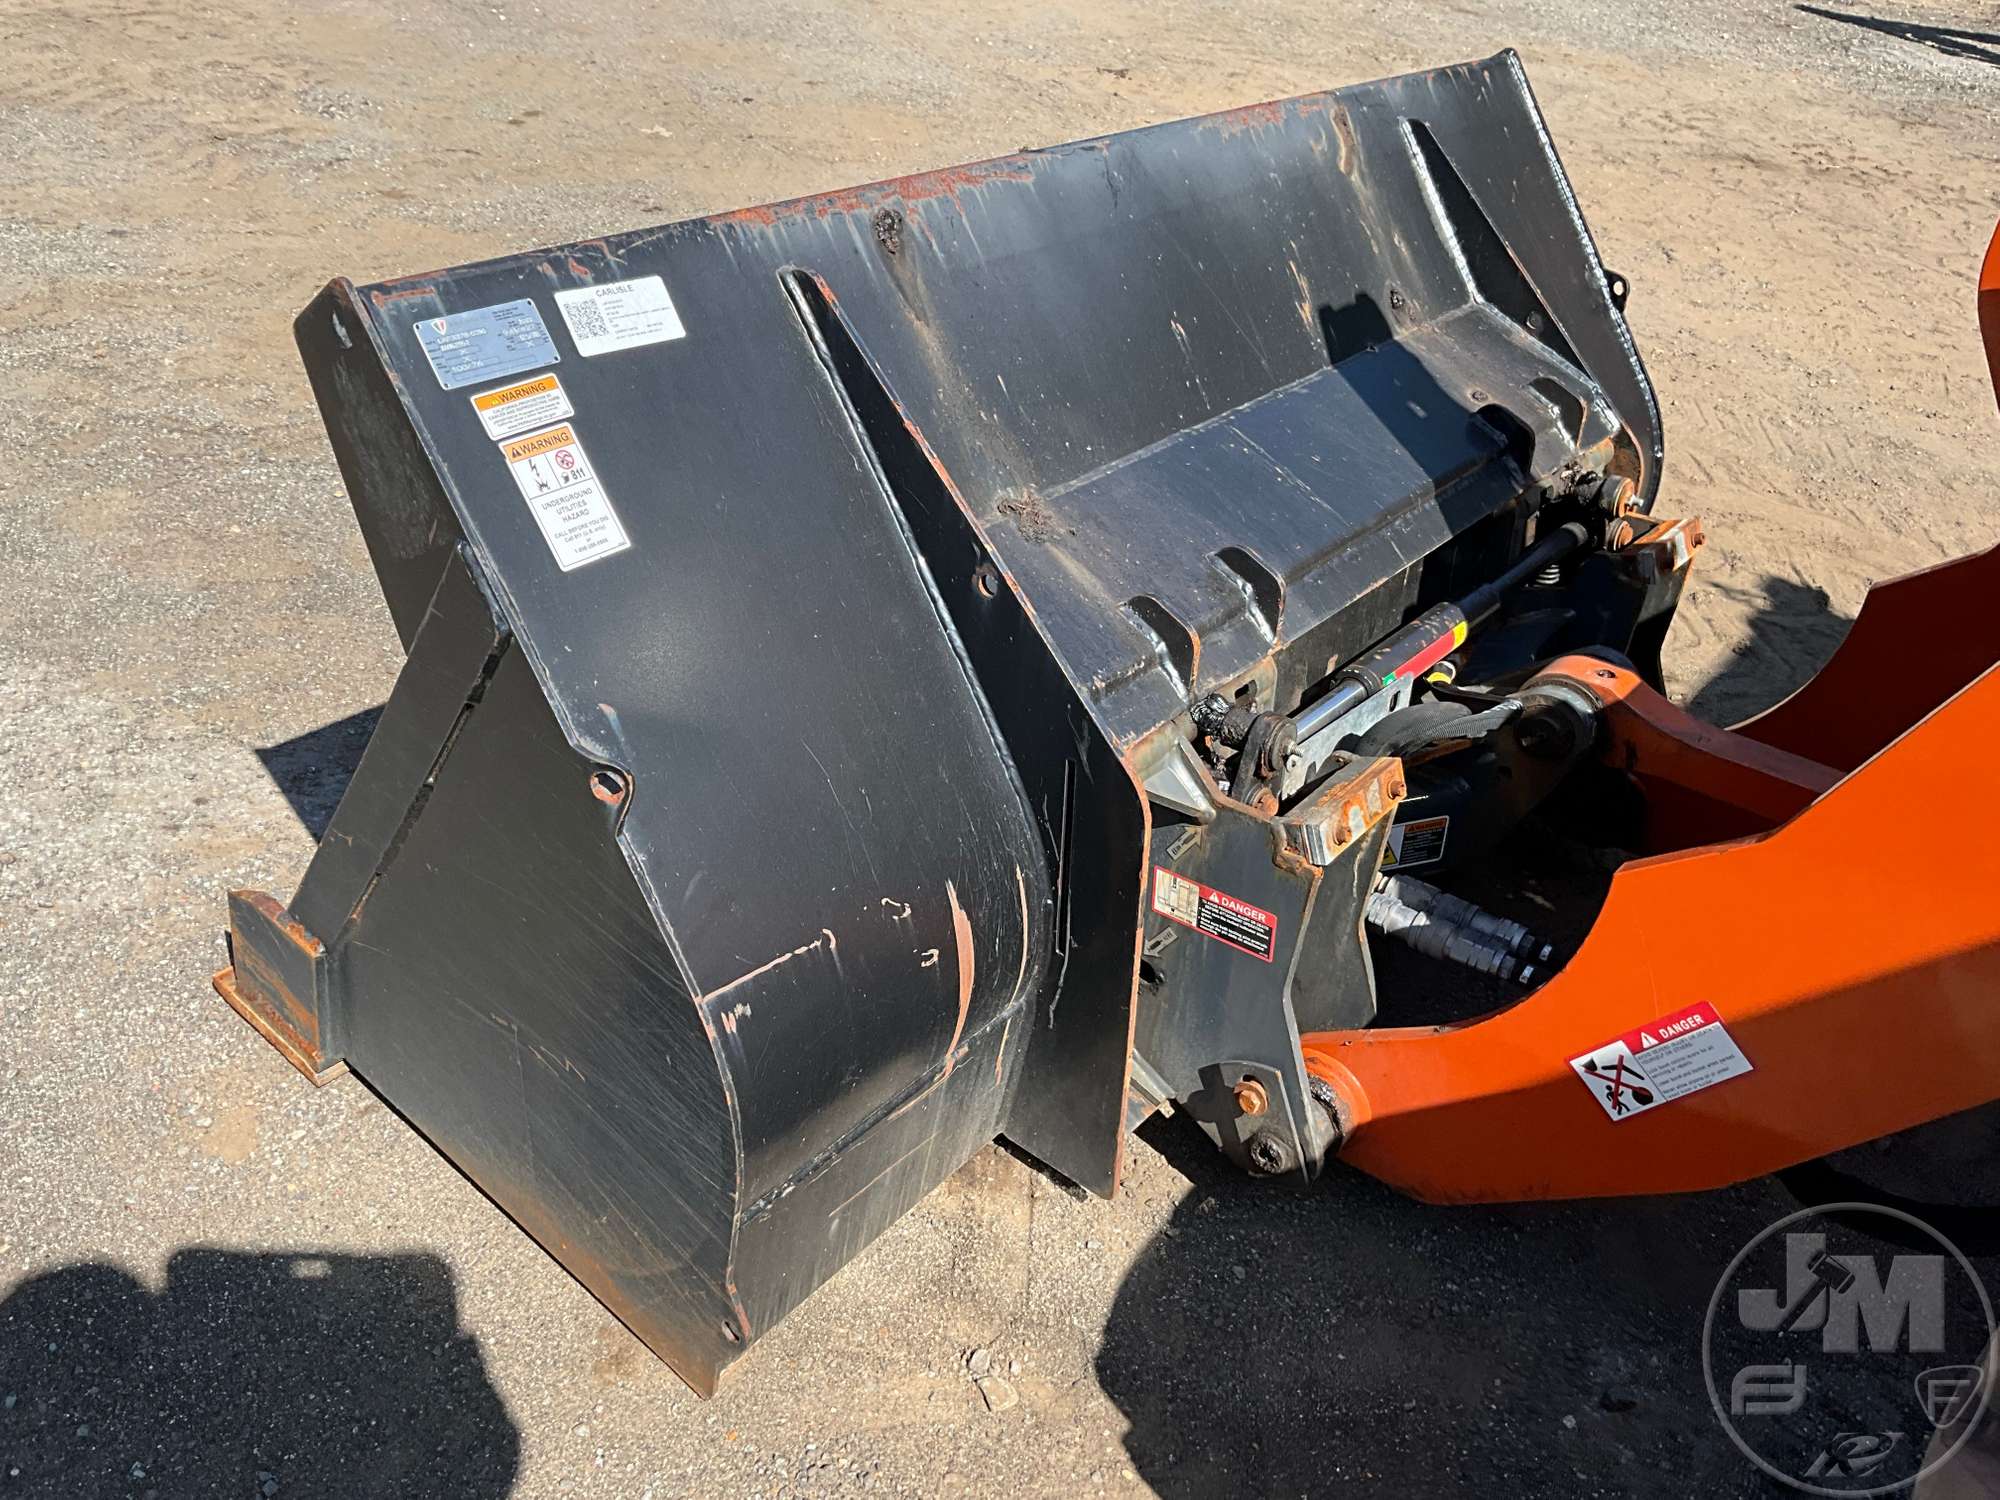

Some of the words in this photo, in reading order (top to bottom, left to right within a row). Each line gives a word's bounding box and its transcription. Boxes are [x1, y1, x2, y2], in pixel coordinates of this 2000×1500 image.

[595, 285, 634, 297] CARLISLE
[500, 383, 546, 402] WARNING
[520, 432, 570, 454] WARNING
[570, 467, 586, 480] 811
[542, 488, 593, 510] UNDERGROUND
[556, 499, 587, 515] UTILITIES
[562, 508, 590, 523] HAZARD
[554, 530, 568, 539] CALL
[1222, 897, 1265, 922] DANGER
[1659, 1013, 1705, 1039] DANGER
